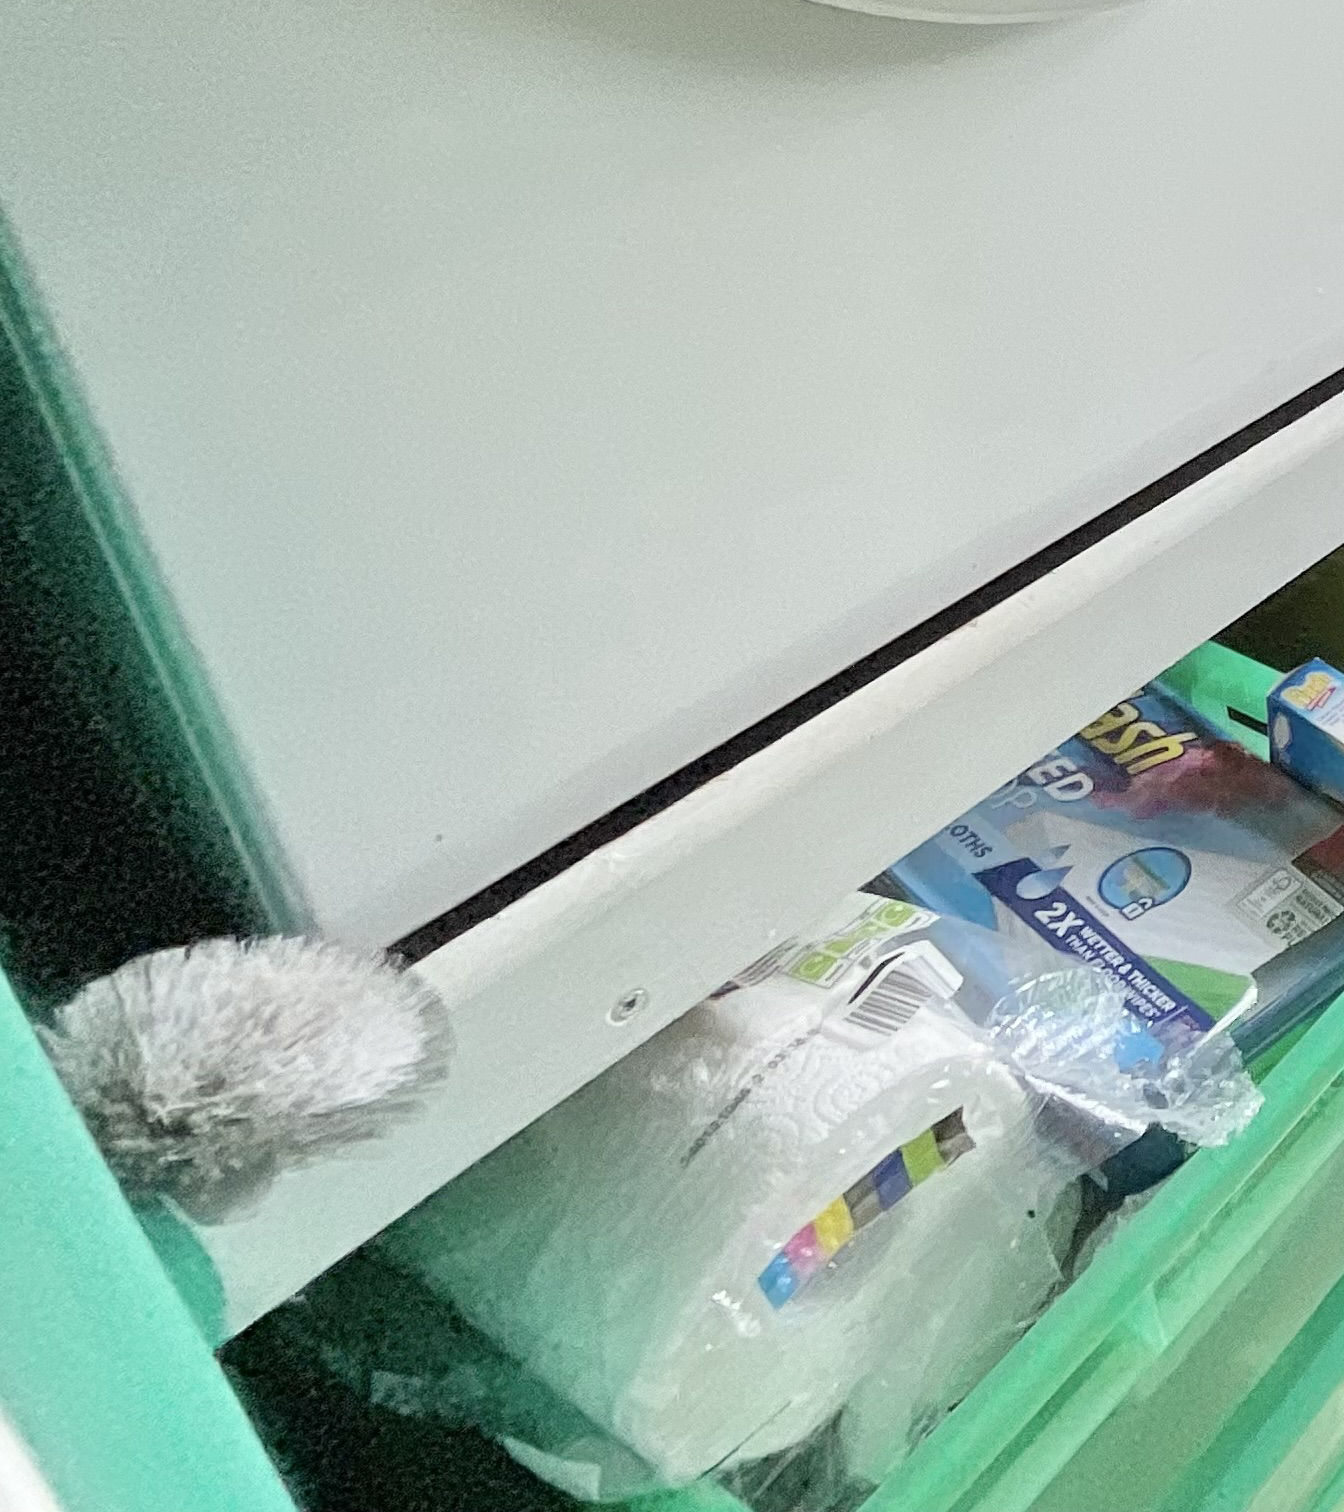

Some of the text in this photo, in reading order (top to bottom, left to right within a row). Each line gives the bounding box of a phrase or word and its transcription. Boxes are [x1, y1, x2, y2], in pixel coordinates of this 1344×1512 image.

[1080, 686, 1200, 776] ash
[947, 823, 994, 859] OTHS
[1033, 901, 1085, 937] 2X
[1065, 935, 1096, 962] THAN
[1079, 926, 1125, 969] WETTER
[1128, 969, 1178, 1013] THICKER
